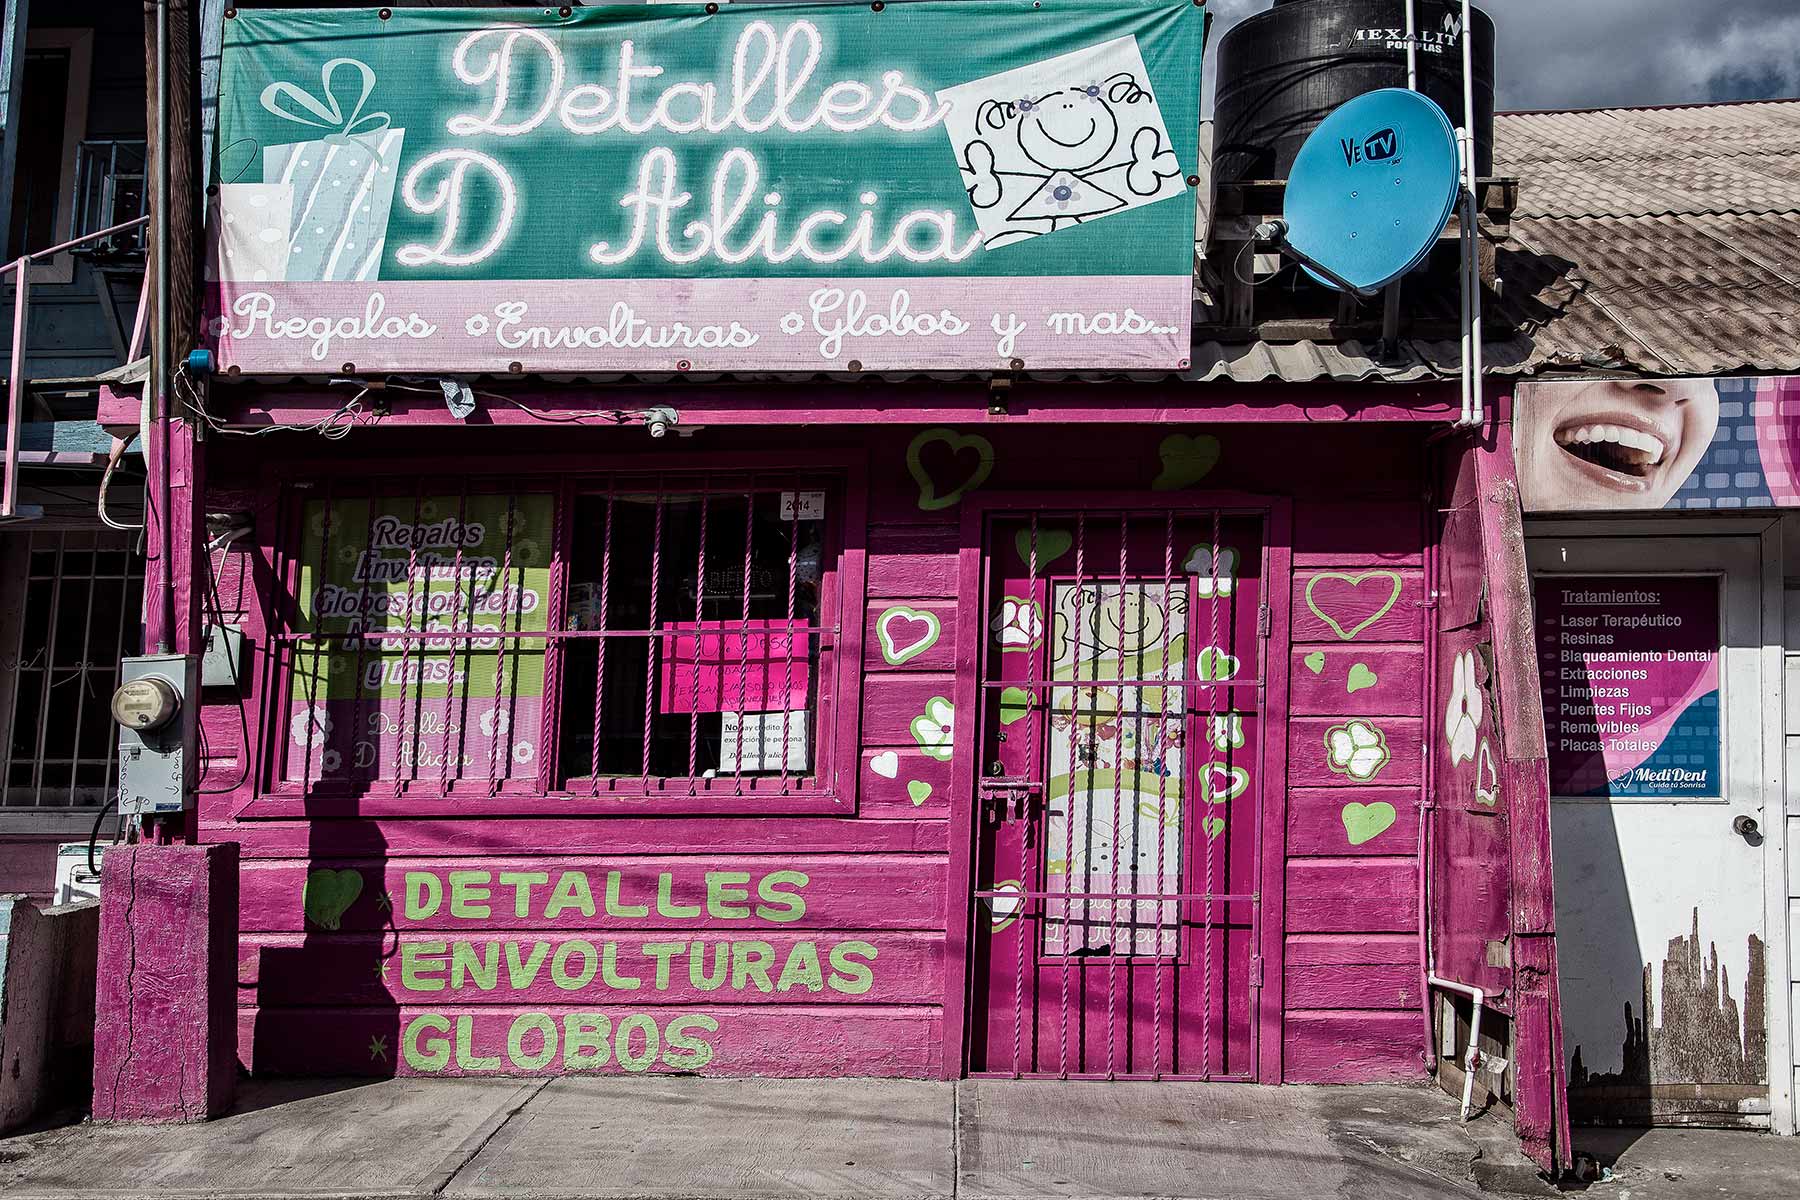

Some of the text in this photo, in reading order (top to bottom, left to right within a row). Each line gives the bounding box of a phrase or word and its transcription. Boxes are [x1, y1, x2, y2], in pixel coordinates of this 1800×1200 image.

[1386, 40, 1443, 53] POLPLAS
[447, 20, 954, 136] Detalles
[395, 146, 986, 266] D Alicia
[232, 288, 1179, 360] Regalos Envolturas Globos y mas...
[785, 500, 810, 511] 214
[376, 519, 482, 548] Regalos
[315, 586, 407, 615] Globos
[1561, 590, 1660, 604] Tratamientos:
[1560, 613, 1682, 629] Laser Terapéutico
[1560, 632, 1614, 645] Resinas
[1560, 649, 1711, 665] Blaqueamiento Dental
[1560, 668, 1648, 681] Extracciones
[1560, 685, 1630, 701] Limpiezas
[1560, 703, 1652, 718] Puentes Fijos
[725, 724, 738, 732] No
[1560, 721, 1640, 734] Removibles
[724, 736, 760, 744] excpción
[772, 736, 803, 744] peona
[1560, 739, 1658, 752] Placas Totales
[354, 741, 376, 768] D
[404, 870, 811, 923] DETALLES
[400, 939, 880, 996] ENVOLTURAS
[403, 1013, 719, 1073] GLOBOS
